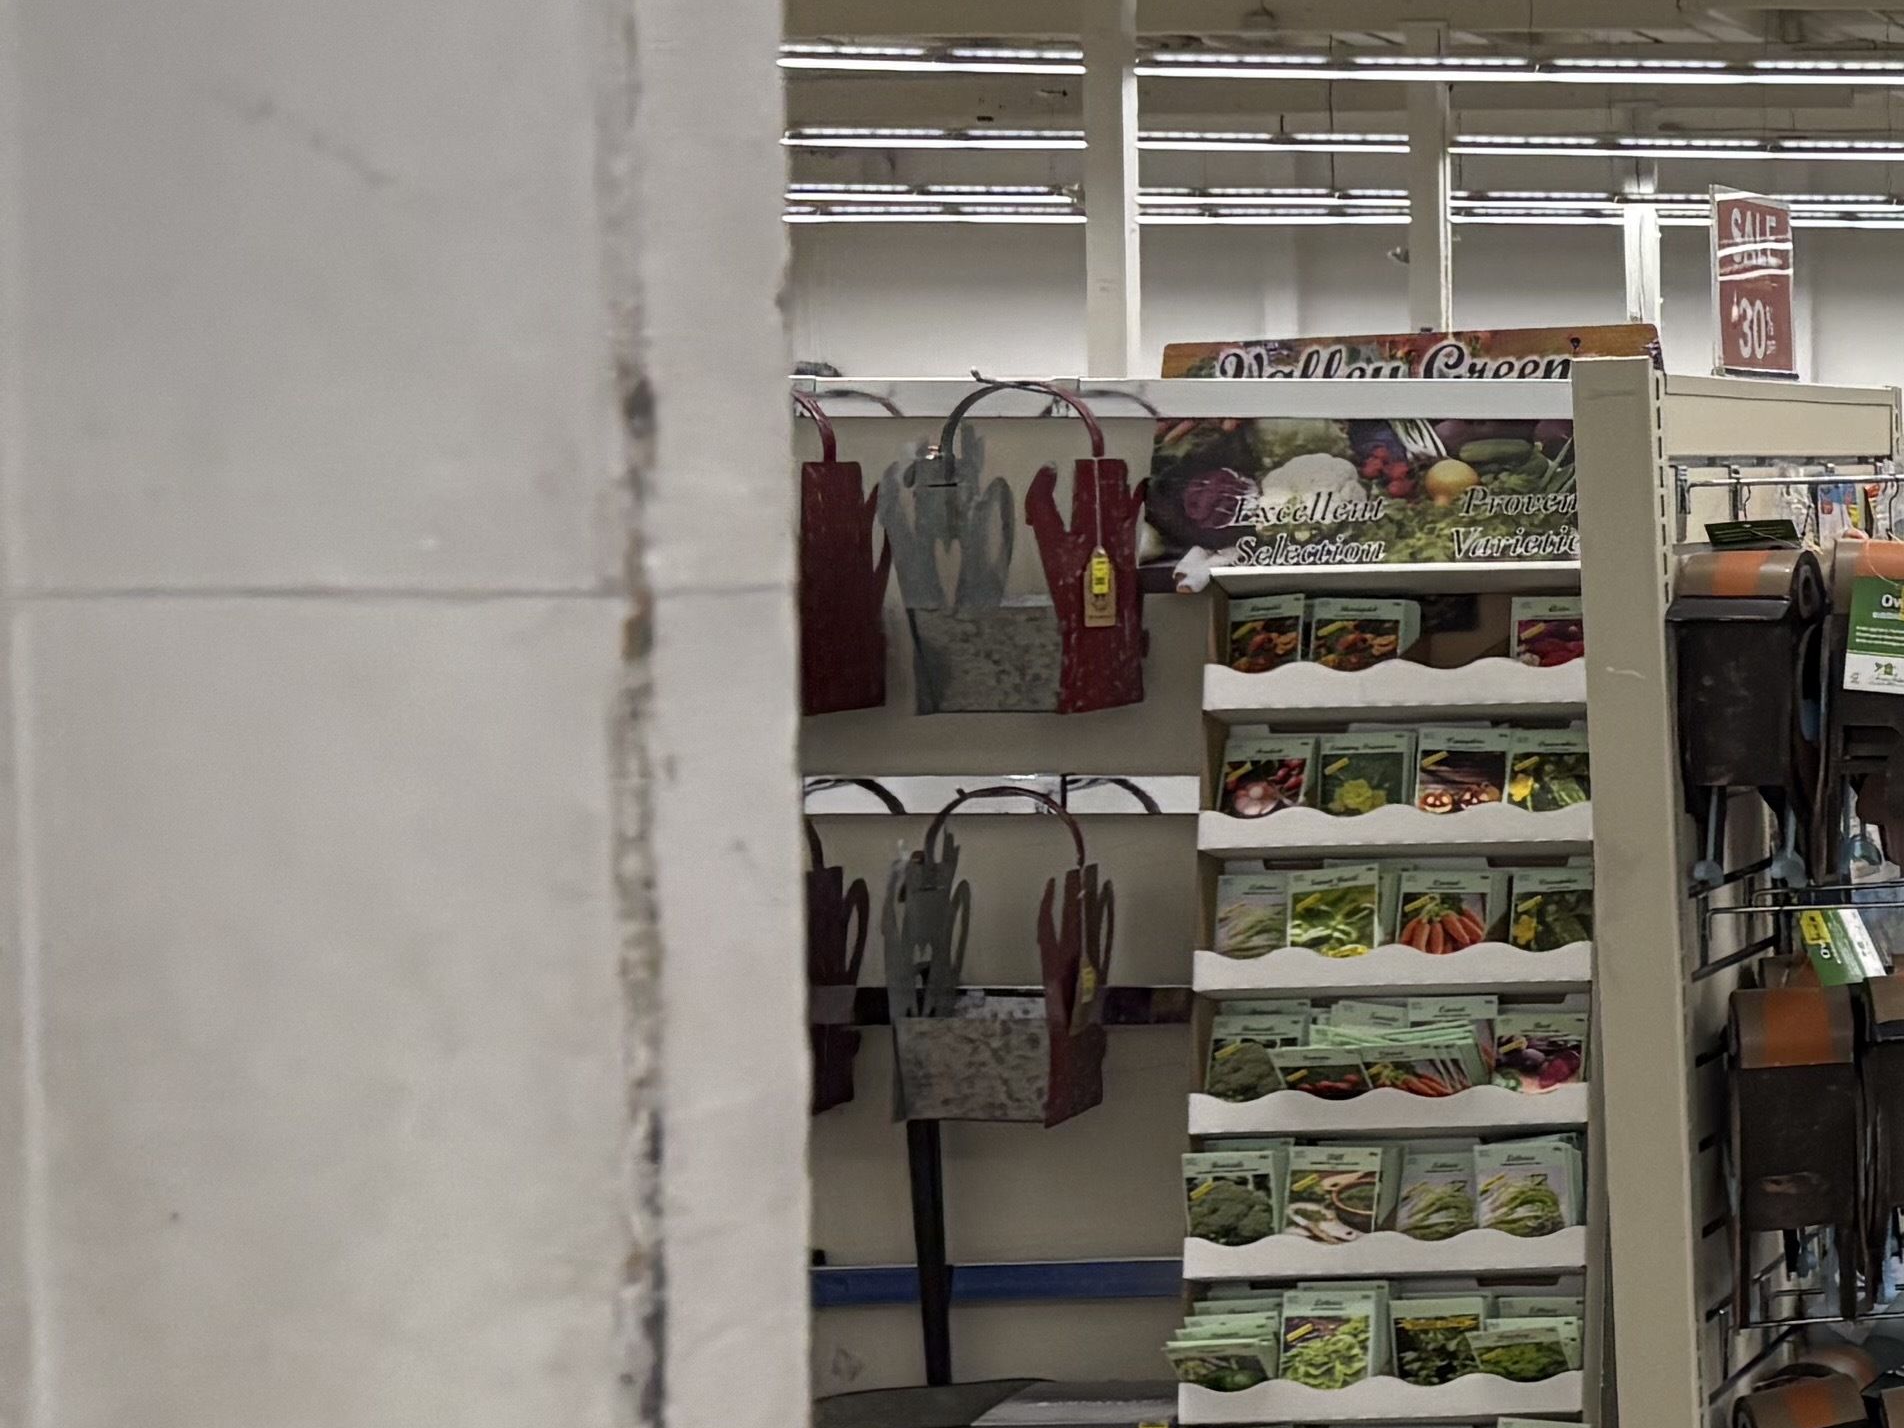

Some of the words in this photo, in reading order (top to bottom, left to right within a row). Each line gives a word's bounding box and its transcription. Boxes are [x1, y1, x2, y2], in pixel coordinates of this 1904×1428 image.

[1731, 207, 1777, 265] SALE
[1219, 346, 1400, 378] Valley
[1232, 491, 1385, 526] Excellent
[1458, 486, 1577, 518] Proven
[1233, 536, 1385, 565] Selection
